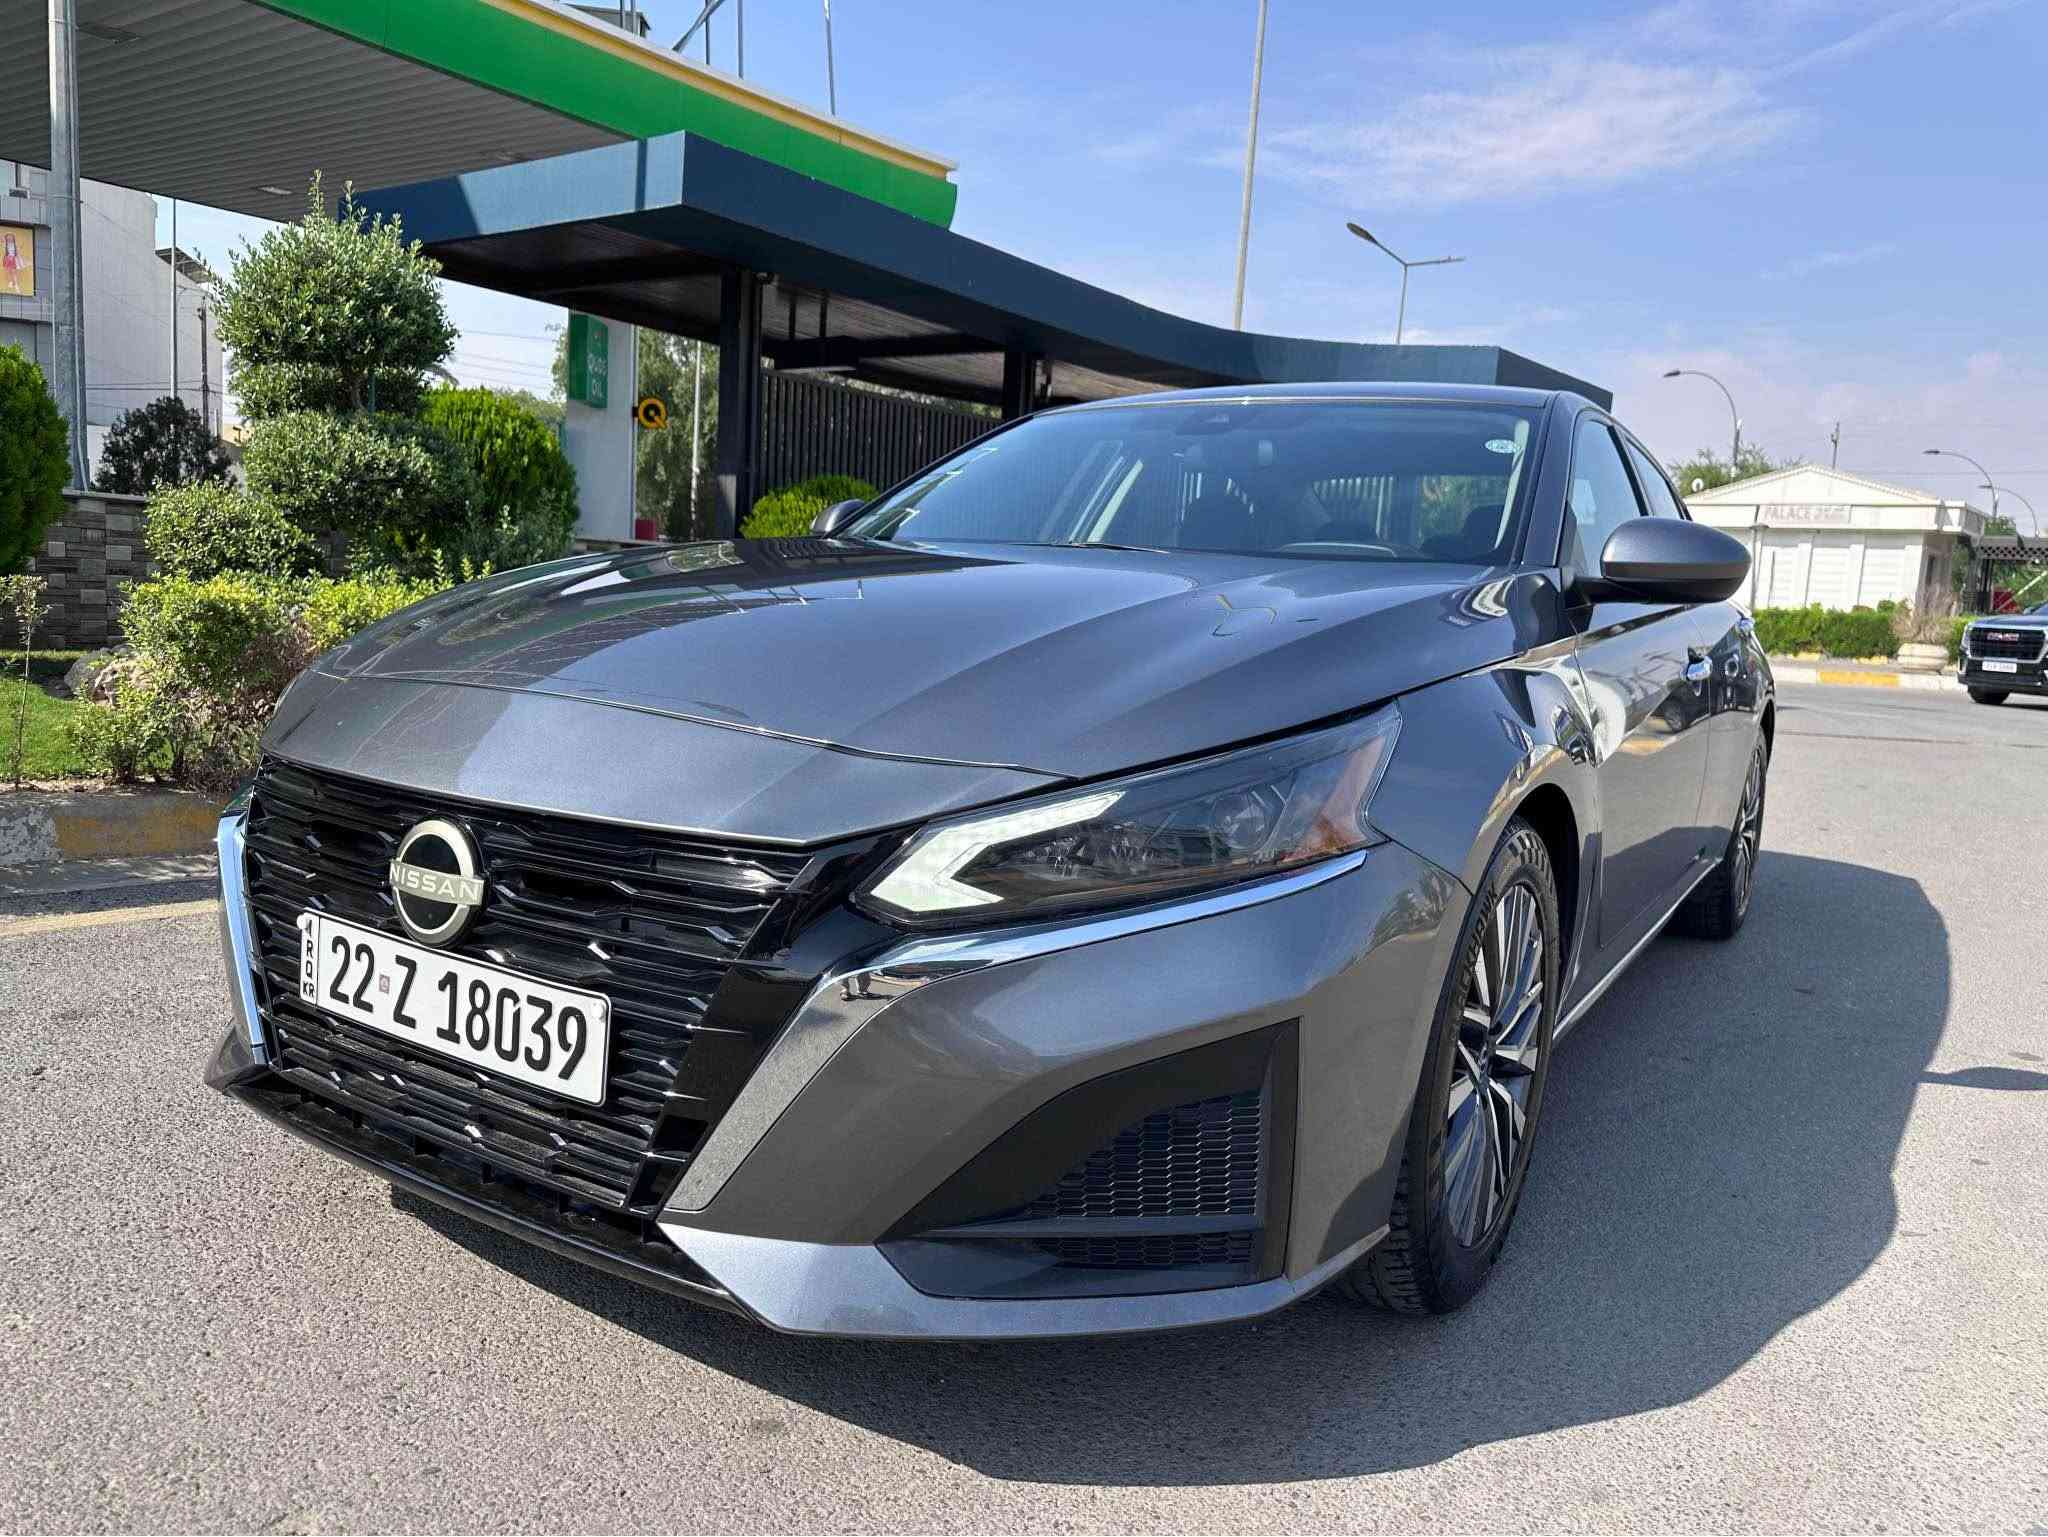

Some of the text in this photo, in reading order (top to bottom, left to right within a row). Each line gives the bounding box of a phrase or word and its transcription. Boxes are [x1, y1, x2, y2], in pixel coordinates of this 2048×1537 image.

[390, 861, 480, 900] NISSAN
[302, 982, 315, 998] KR
[329, 935, 587, 1081] 22 Z 18039
